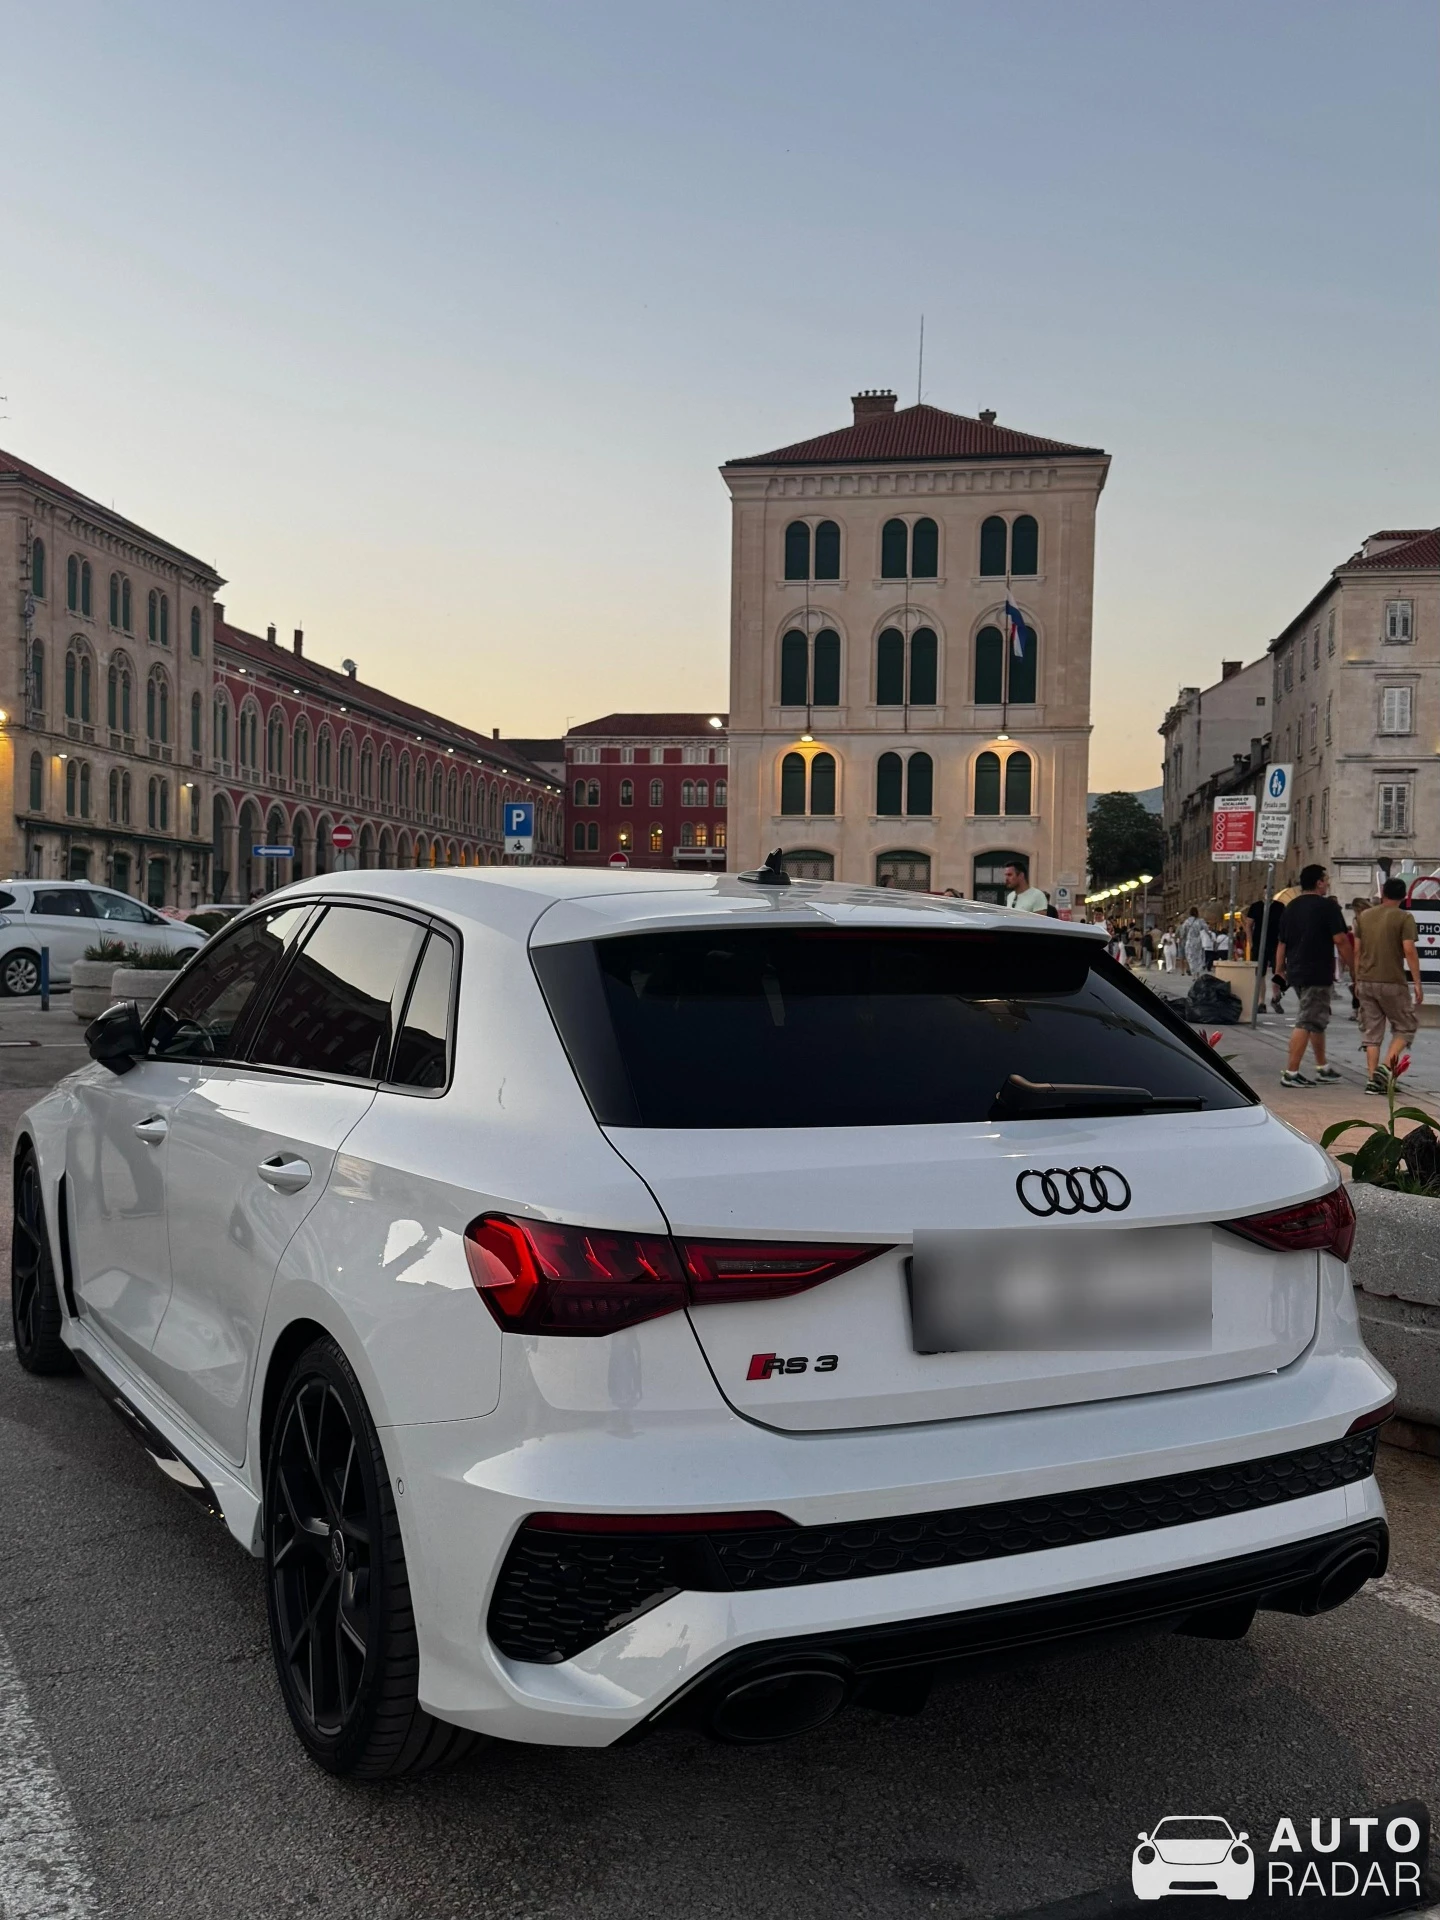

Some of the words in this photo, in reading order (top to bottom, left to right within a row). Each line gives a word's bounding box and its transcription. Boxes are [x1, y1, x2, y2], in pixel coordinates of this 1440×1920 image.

[512, 809, 526, 831] P
[762, 1357, 809, 1376] RS
[814, 1354, 839, 1372] 3
